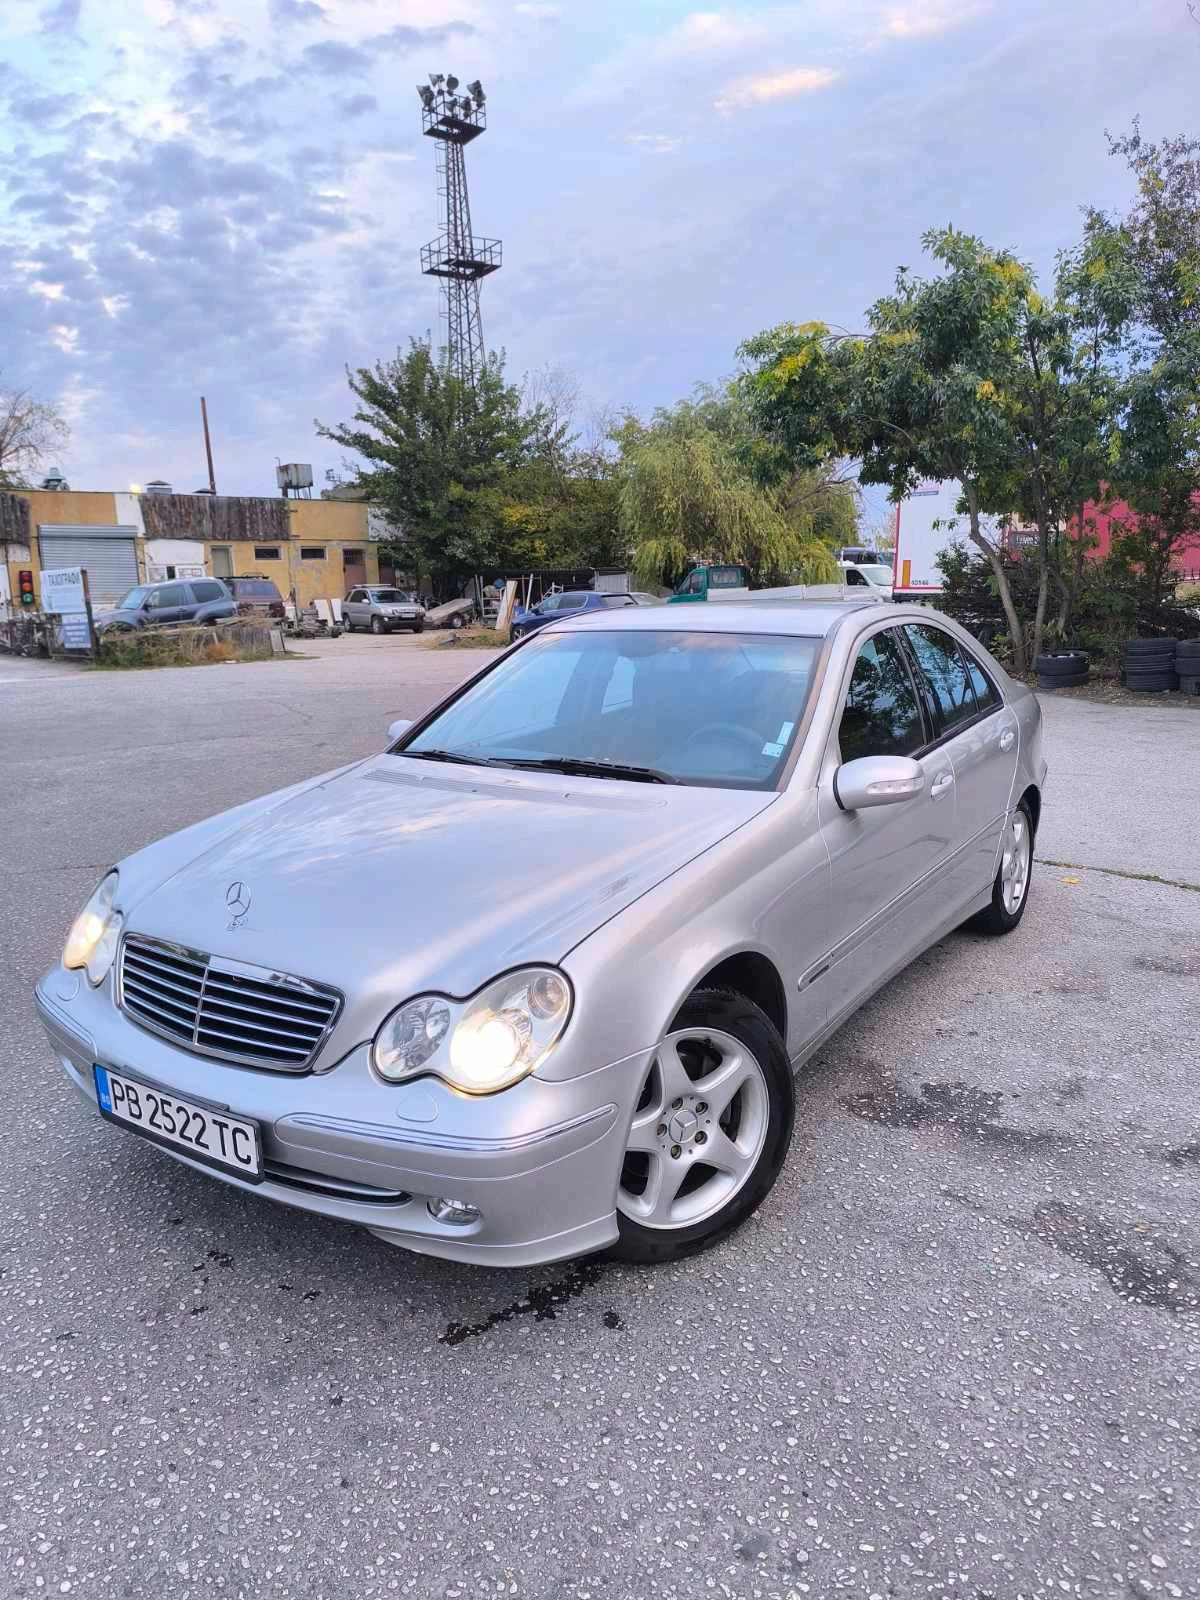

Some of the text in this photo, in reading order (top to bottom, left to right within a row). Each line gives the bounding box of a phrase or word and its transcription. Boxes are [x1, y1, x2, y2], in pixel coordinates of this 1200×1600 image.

[110, 1077, 252, 1165] PB 2522 TC
